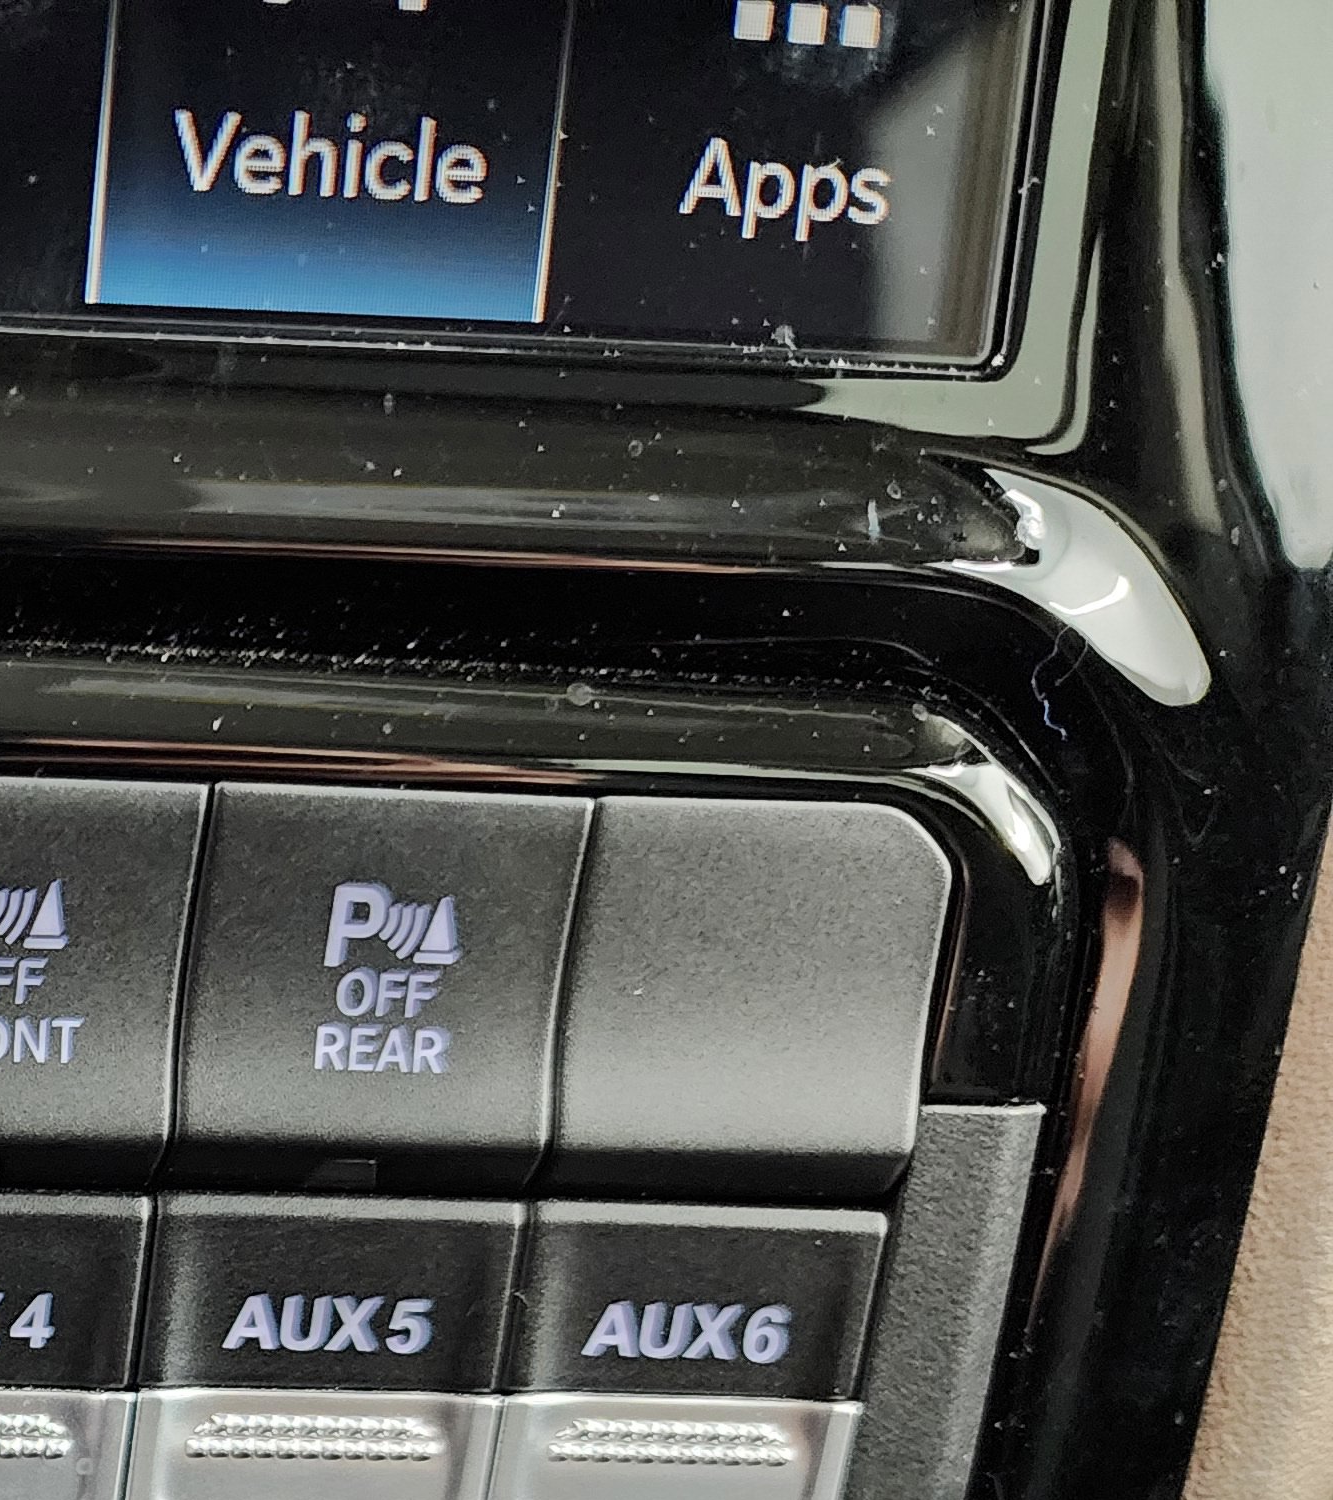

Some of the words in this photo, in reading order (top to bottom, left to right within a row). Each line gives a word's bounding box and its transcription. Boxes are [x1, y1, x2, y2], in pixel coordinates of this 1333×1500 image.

[178, 113, 484, 202] Vehicle
[680, 138, 891, 241] Apps
[337, 972, 439, 1017] OFF
[314, 1024, 451, 1074] REAR
